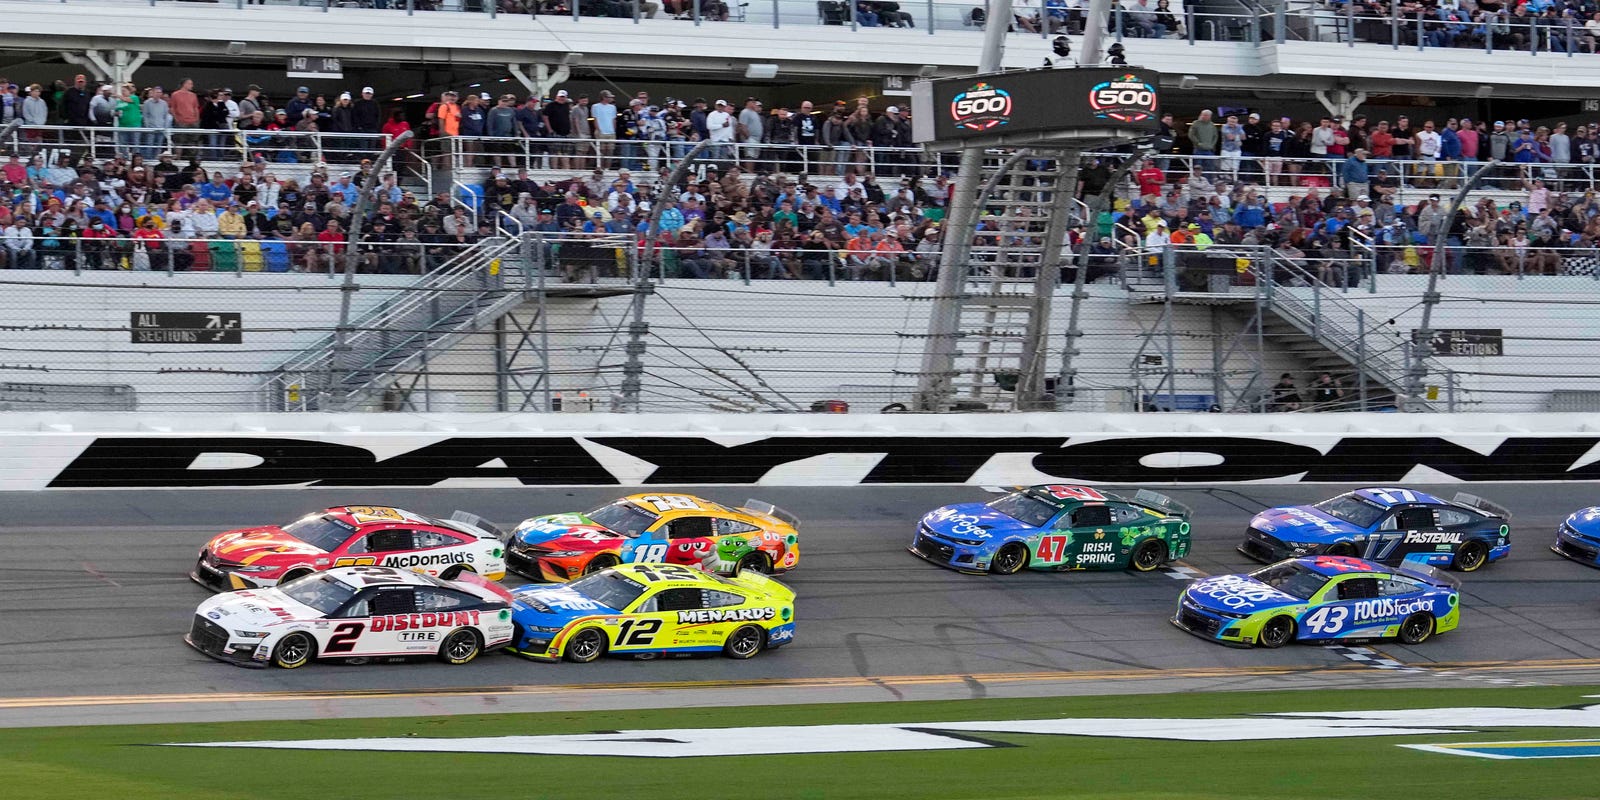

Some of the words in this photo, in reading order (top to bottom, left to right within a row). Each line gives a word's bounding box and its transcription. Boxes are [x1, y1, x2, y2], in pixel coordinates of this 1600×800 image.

[956, 97, 1006, 115] 500
[1097, 90, 1153, 106] 500
[138, 313, 160, 327] ALL
[138, 330, 199, 342] SECTIONS
[1450, 343, 1499, 355] SECTIONS
[47, 437, 1600, 486] DAYTON
[642, 495, 700, 513] 18
[1365, 488, 1417, 504] 17
[1363, 532, 1404, 559] 17
[1404, 530, 1463, 544] FASTENAL
[634, 544, 668, 563] 18
[1036, 535, 1067, 563] 47
[1082, 542, 1113, 552] IRISH
[384, 551, 475, 568] McDonald's
[1076, 553, 1116, 563] SPRING
[633, 565, 698, 582] 12
[678, 607, 776, 625] MENARDS
[1354, 598, 1395, 620] FOCUS
[1394, 598, 1435, 615] factor
[369, 609, 481, 633] DISCOUNT
[1306, 606, 1349, 634] 43
[324, 622, 366, 653] 2
[402, 632, 435, 640] TIRE
[613, 618, 664, 646] 12
